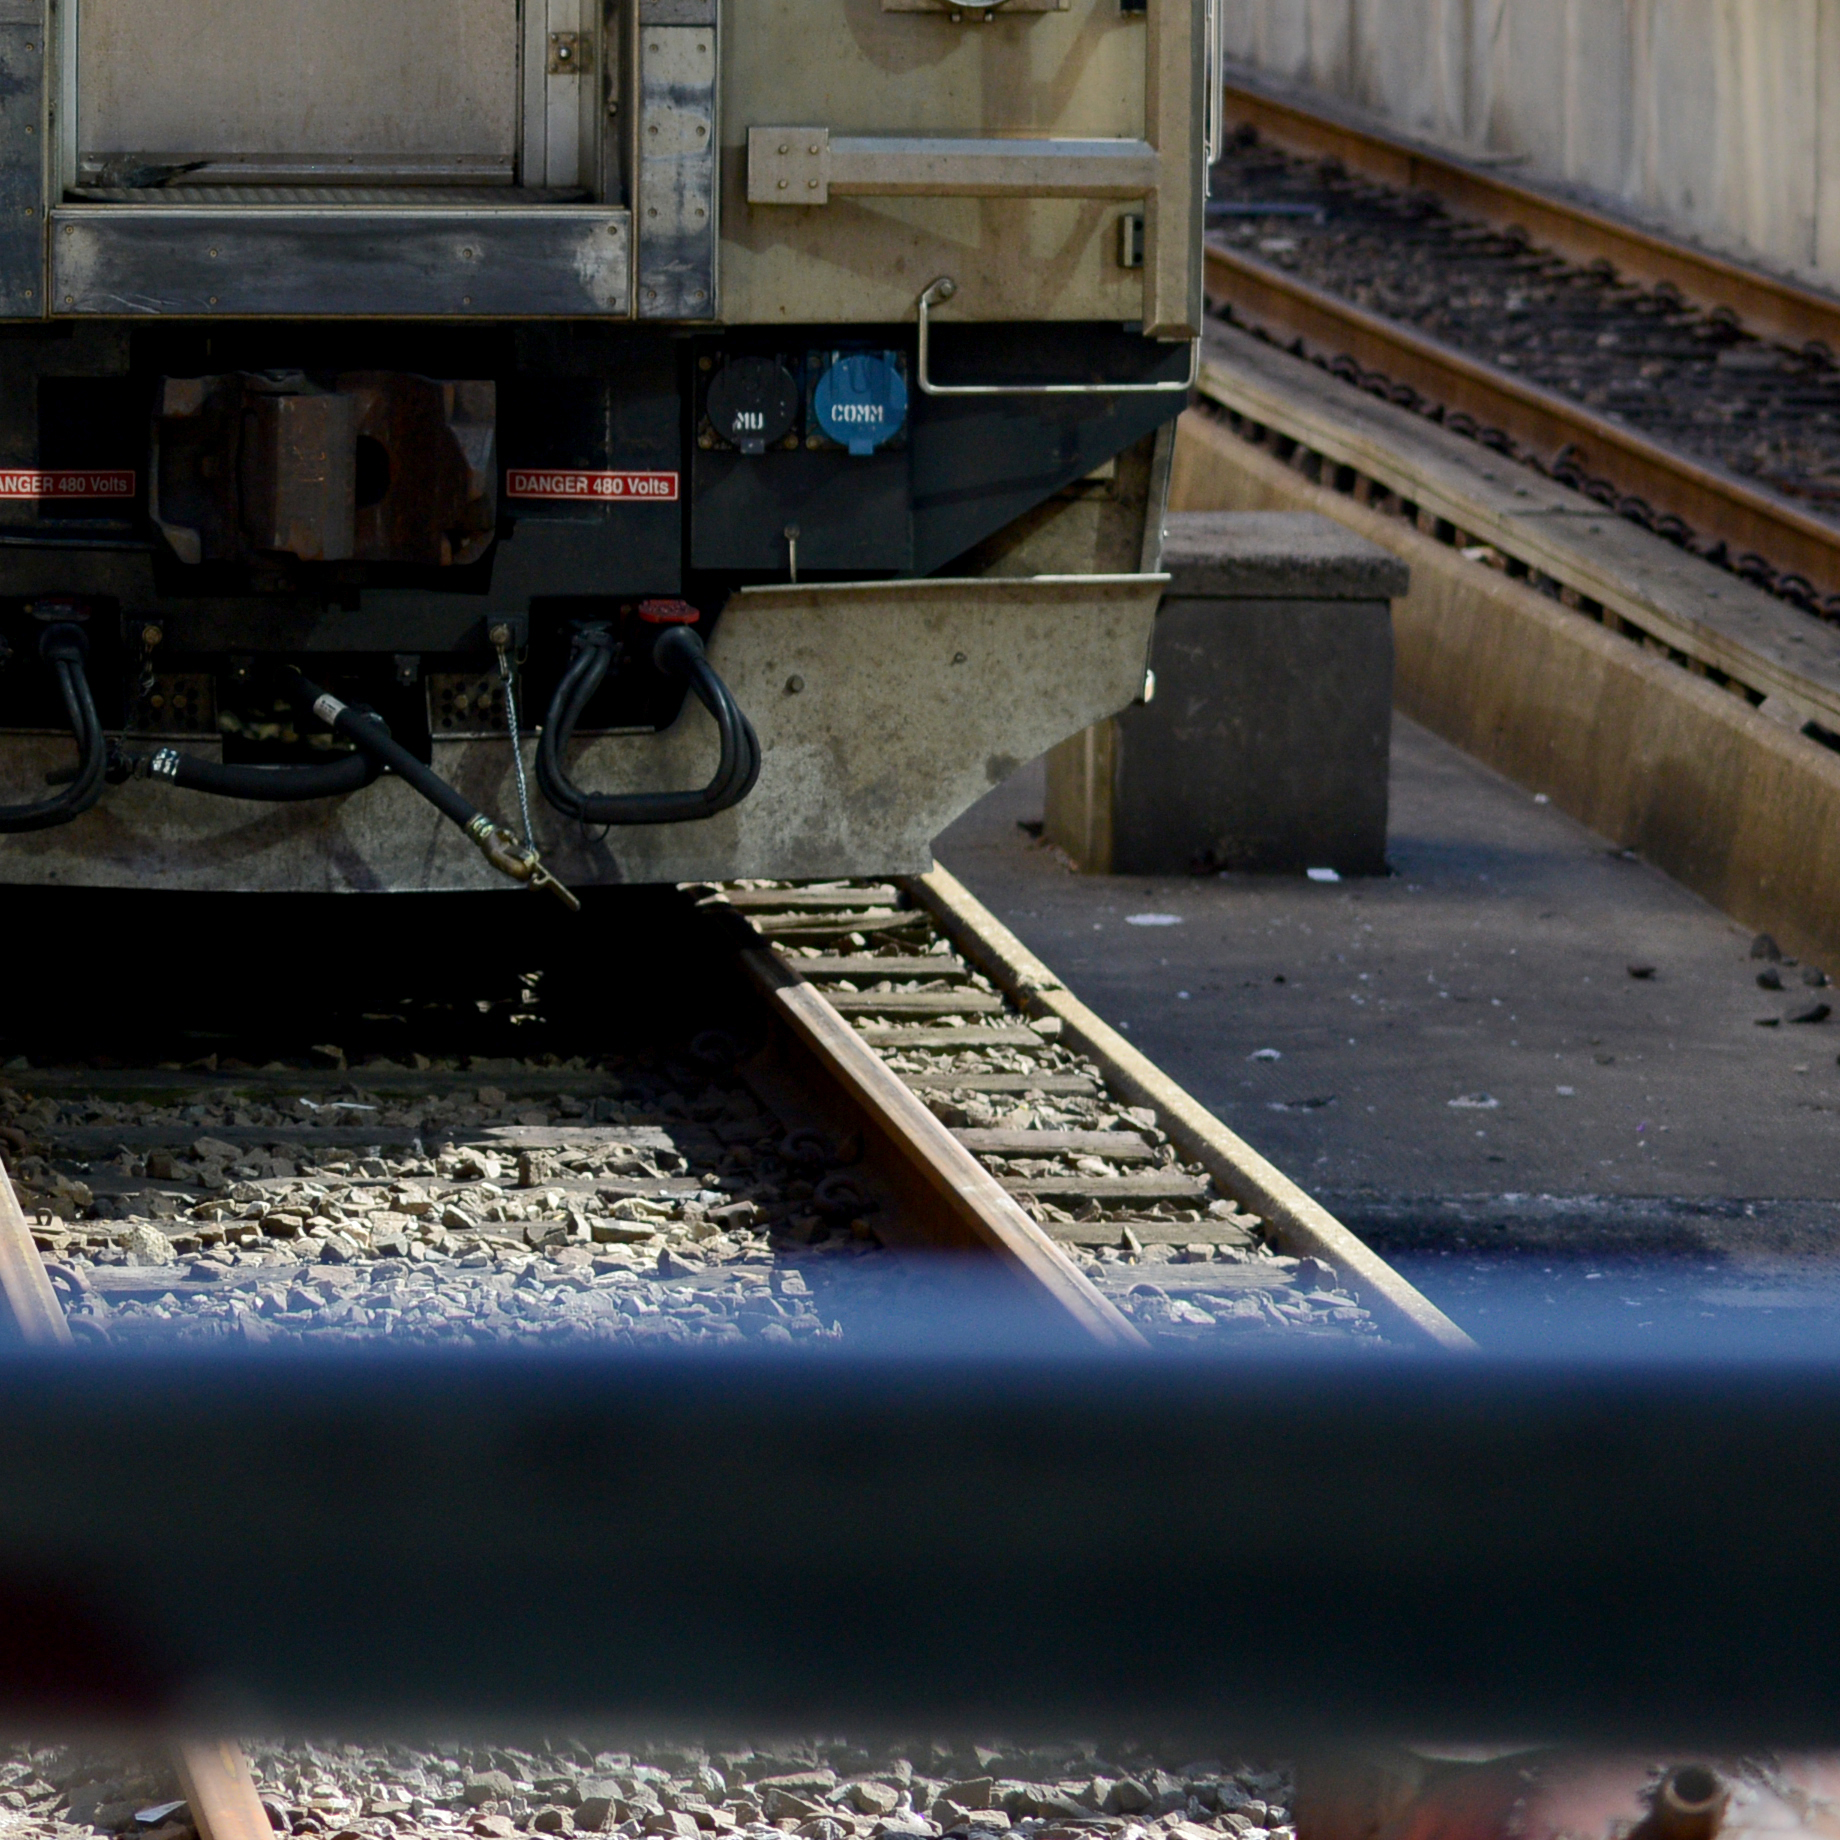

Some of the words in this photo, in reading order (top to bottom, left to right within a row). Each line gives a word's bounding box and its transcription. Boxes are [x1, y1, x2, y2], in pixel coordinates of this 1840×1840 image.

[736, 411, 764, 431] MU
[831, 404, 884, 423] COMM
[58, 476, 86, 492] 480
[90, 476, 128, 492] Volts
[515, 475, 588, 493] DANGER
[593, 477, 624, 494] 480
[627, 477, 670, 495] Volts
